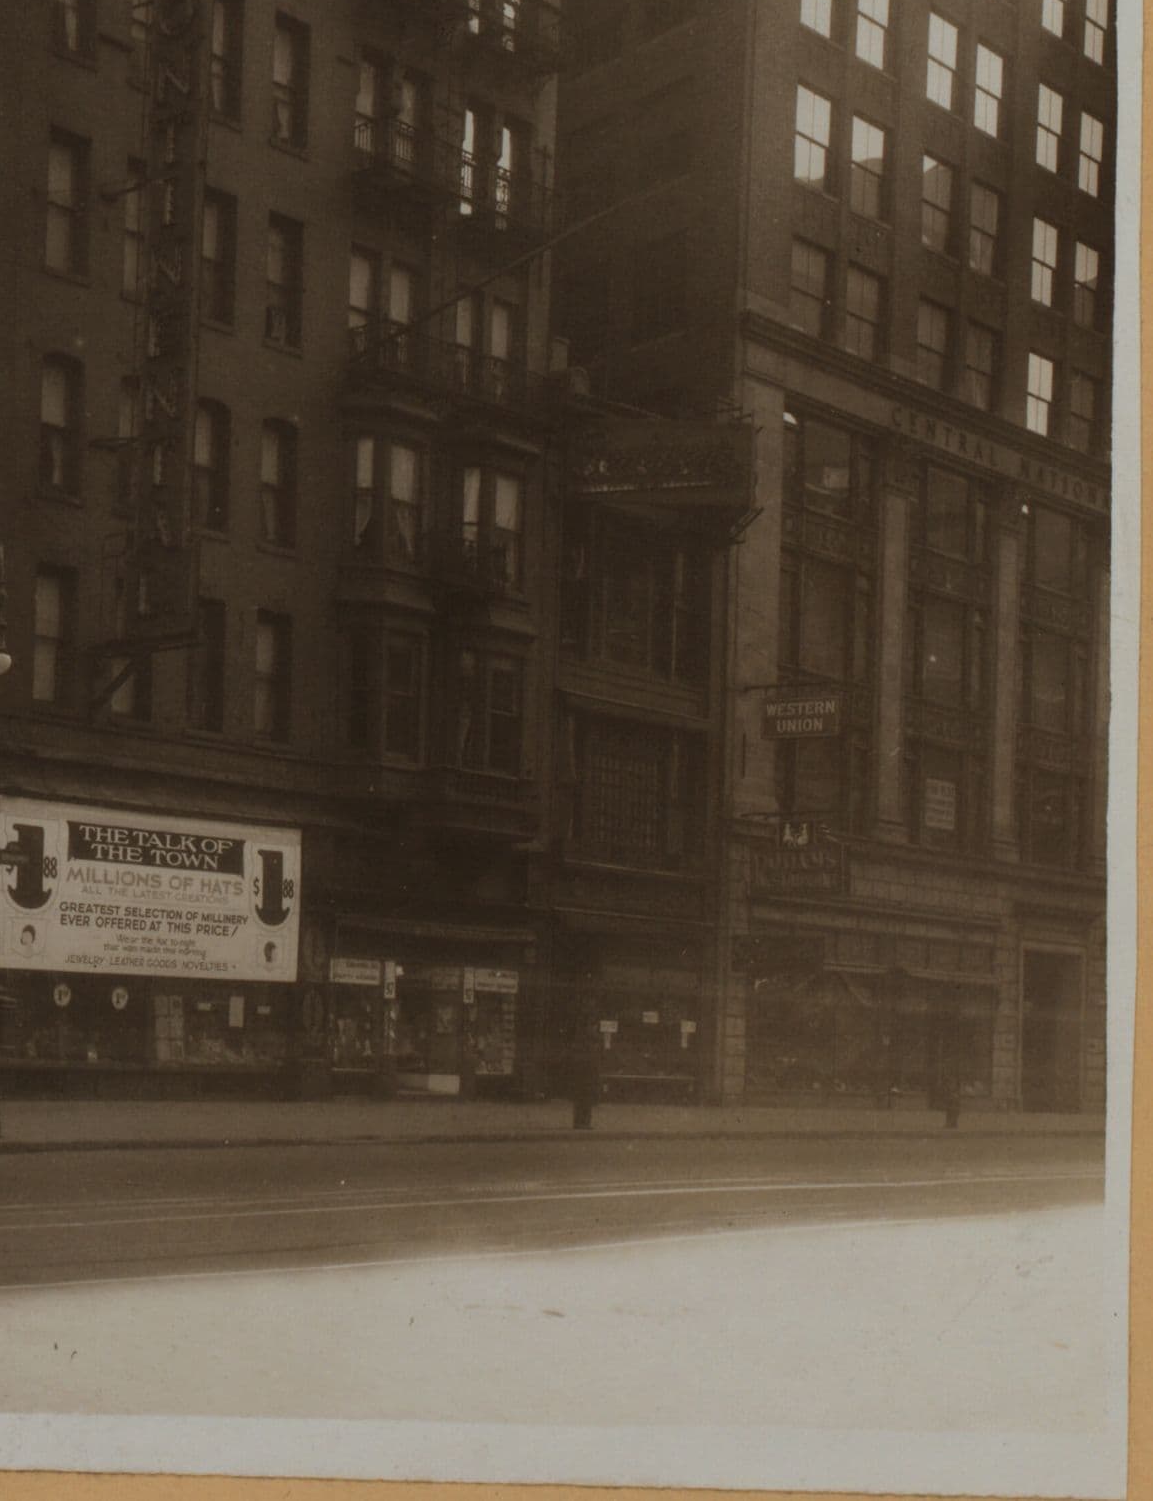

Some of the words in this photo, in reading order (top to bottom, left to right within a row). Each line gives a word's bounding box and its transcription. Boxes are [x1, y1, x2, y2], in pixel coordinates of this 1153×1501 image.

[890, 406, 999, 468] CENTRAL
[766, 700, 836, 716] WESTERN
[777, 718, 823, 733] UNION
[79, 825, 129, 844] THE
[133, 831, 197, 853] TALK
[201, 839, 233, 854] OF
[91, 843, 143, 862] THE
[150, 849, 219, 870] TOWN
[66, 866, 162, 888] MILLIONS
[168, 875, 194, 891] OF
[200, 879, 244, 896] HATS
[59, 901, 120, 916] GREATEST
[124, 906, 183, 921] SELECTION
[185, 911, 199, 921] OF
[201, 912, 248, 926] MILLINERY
[60, 914, 90, 927] EVER
[95, 916, 147, 931] OFFERED
[149, 921, 162, 932] AT
[167, 922, 191, 934] THIS
